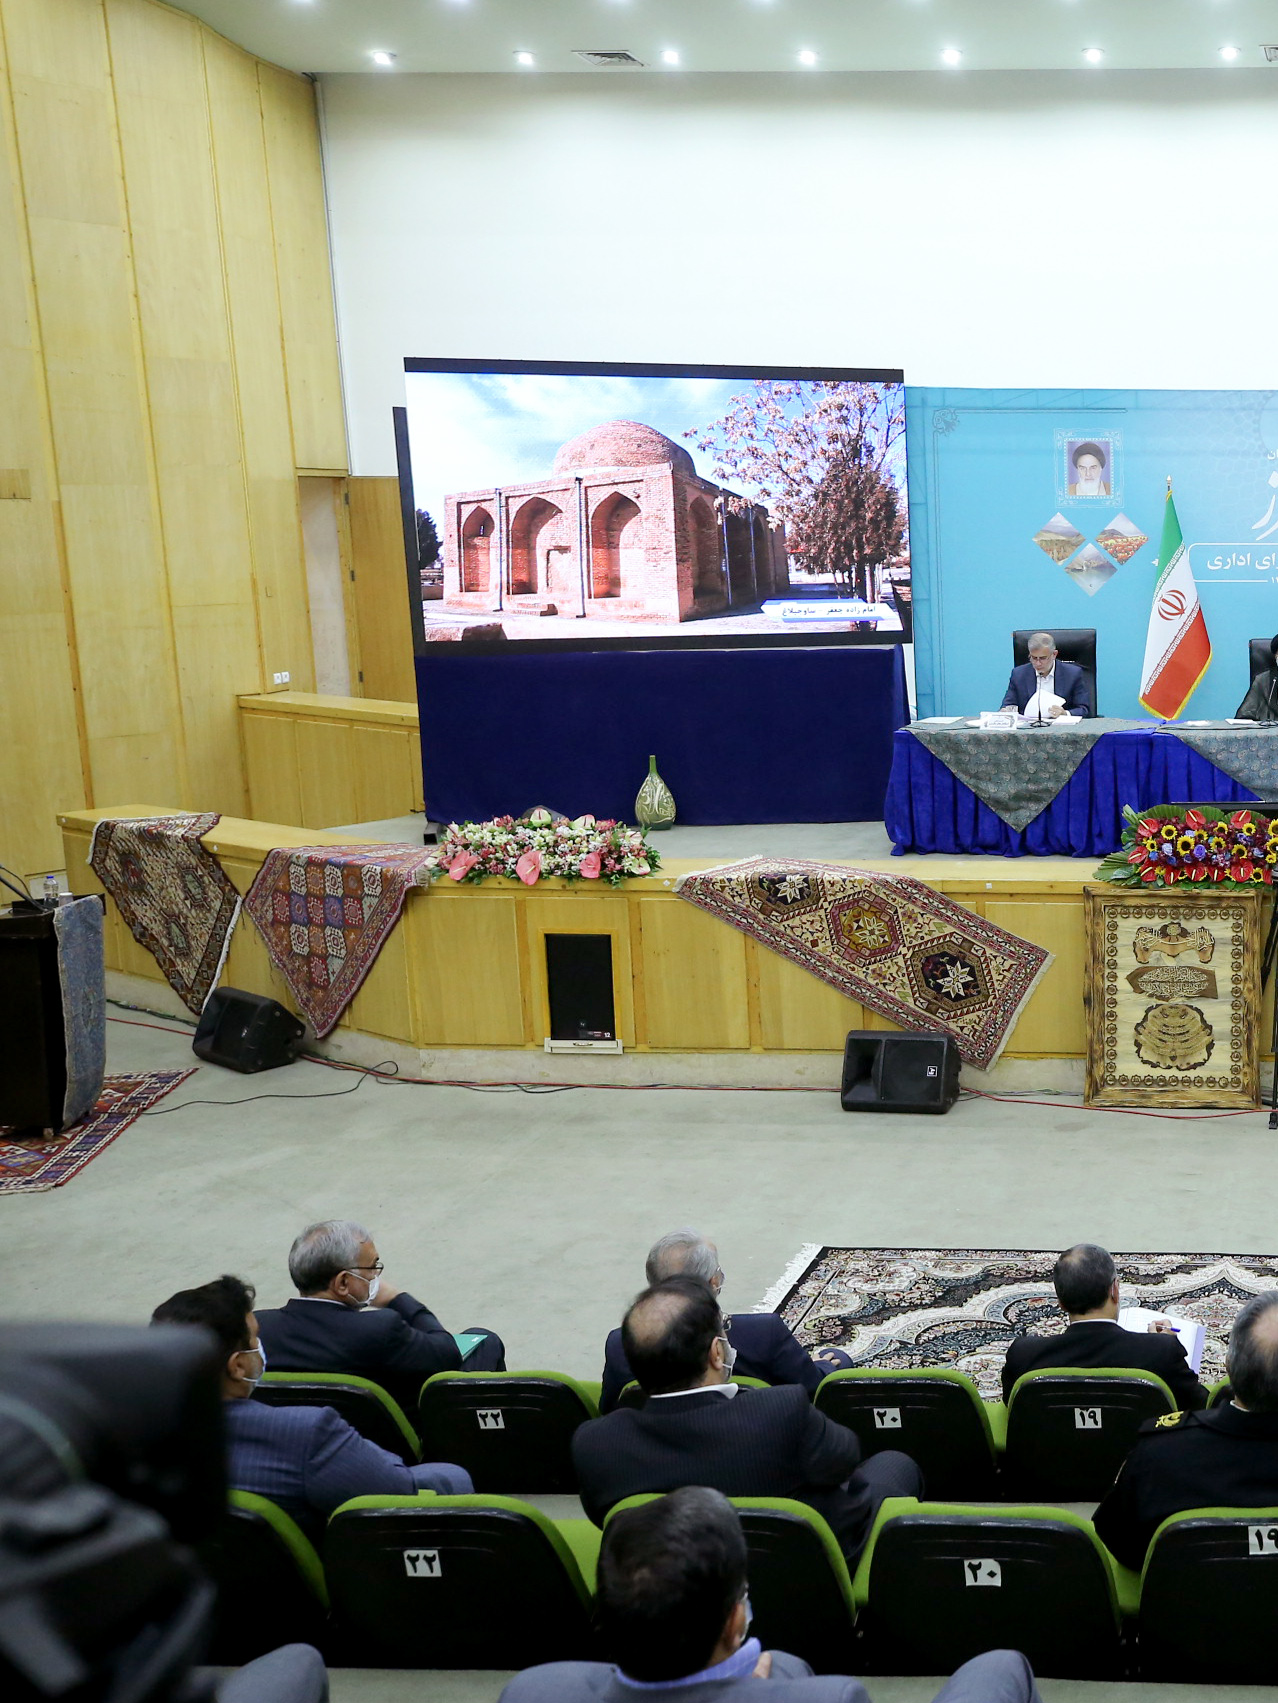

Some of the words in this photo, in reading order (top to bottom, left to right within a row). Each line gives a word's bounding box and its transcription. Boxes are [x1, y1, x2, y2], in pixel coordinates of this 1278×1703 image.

[1207, 553, 1251, 570] اداری
[862, 606, 876, 614] امام
[479, 1412, 500, 1427] ۲۲
[876, 1410, 898, 1426] ۲۰
[1080, 1410, 1099, 1426] ۱۹
[406, 1554, 436, 1573] ۲۲
[967, 1561, 998, 1583] ۲۰
